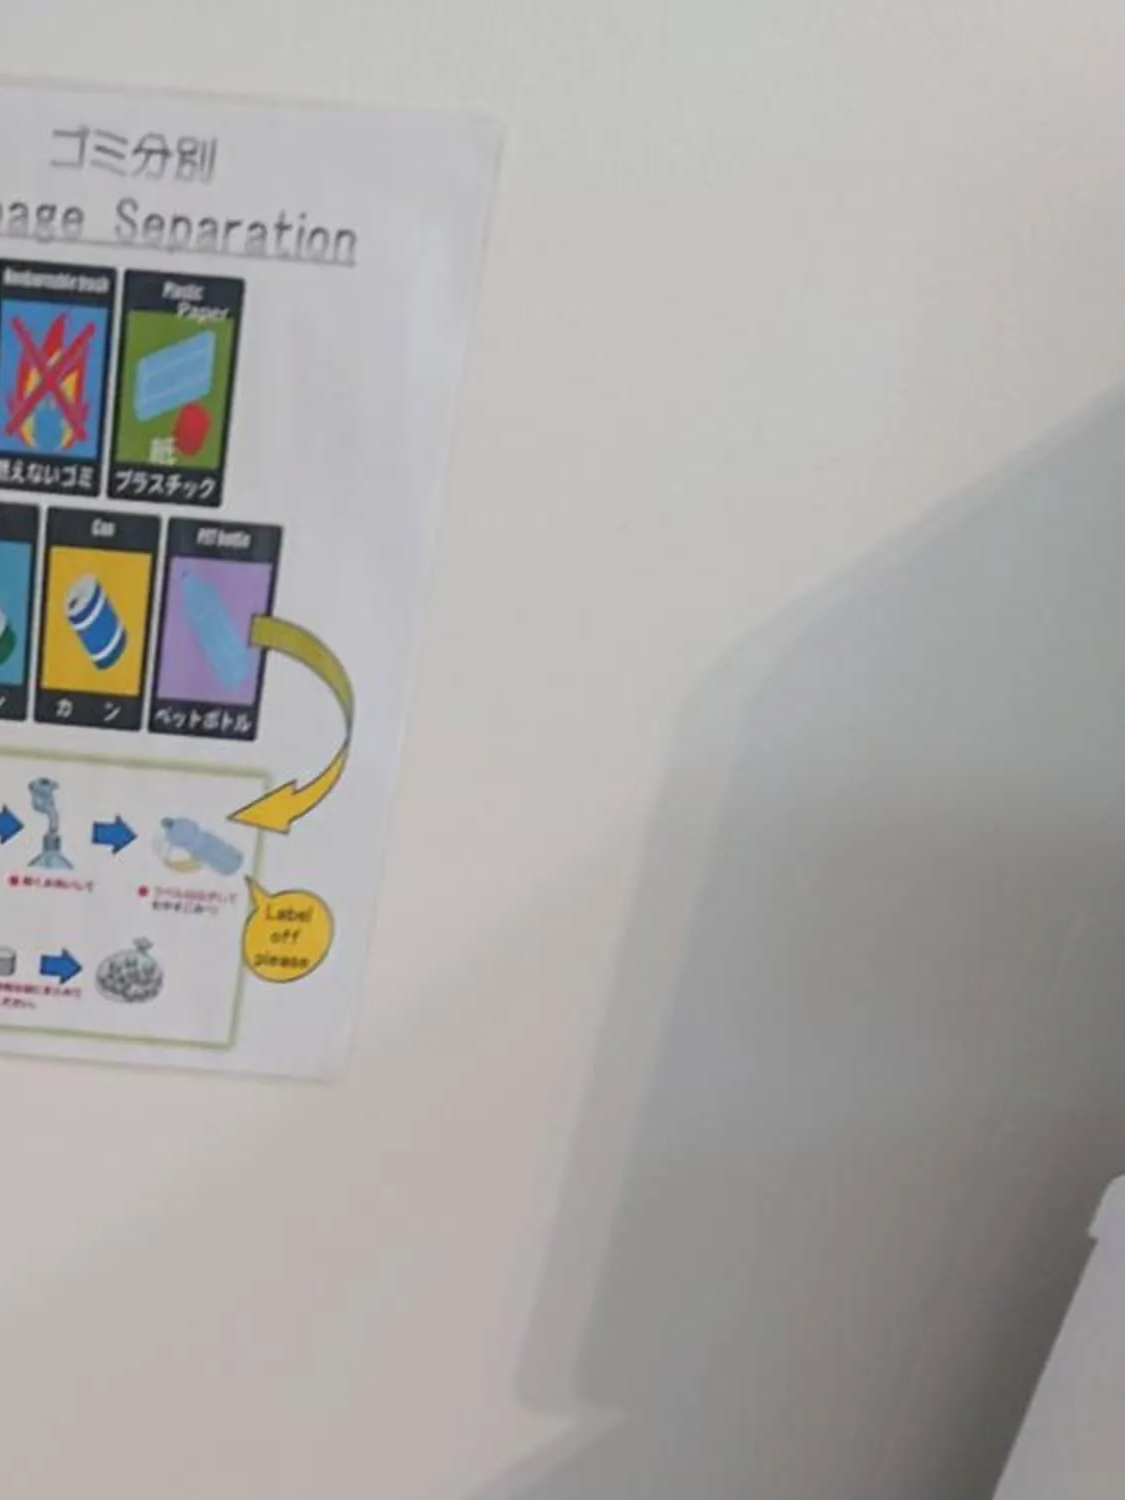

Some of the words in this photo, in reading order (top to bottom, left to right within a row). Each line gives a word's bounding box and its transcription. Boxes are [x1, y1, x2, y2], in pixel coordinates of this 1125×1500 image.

[49, 125, 218, 184] ゴミ分別
[115, 199, 359, 264] Separation
[115, 468, 217, 500] プラスチック
[154, 706, 253, 733] ペットボトル
[265, 903, 315, 923] Label
[269, 929, 301, 945] off
[254, 952, 309, 970] please
